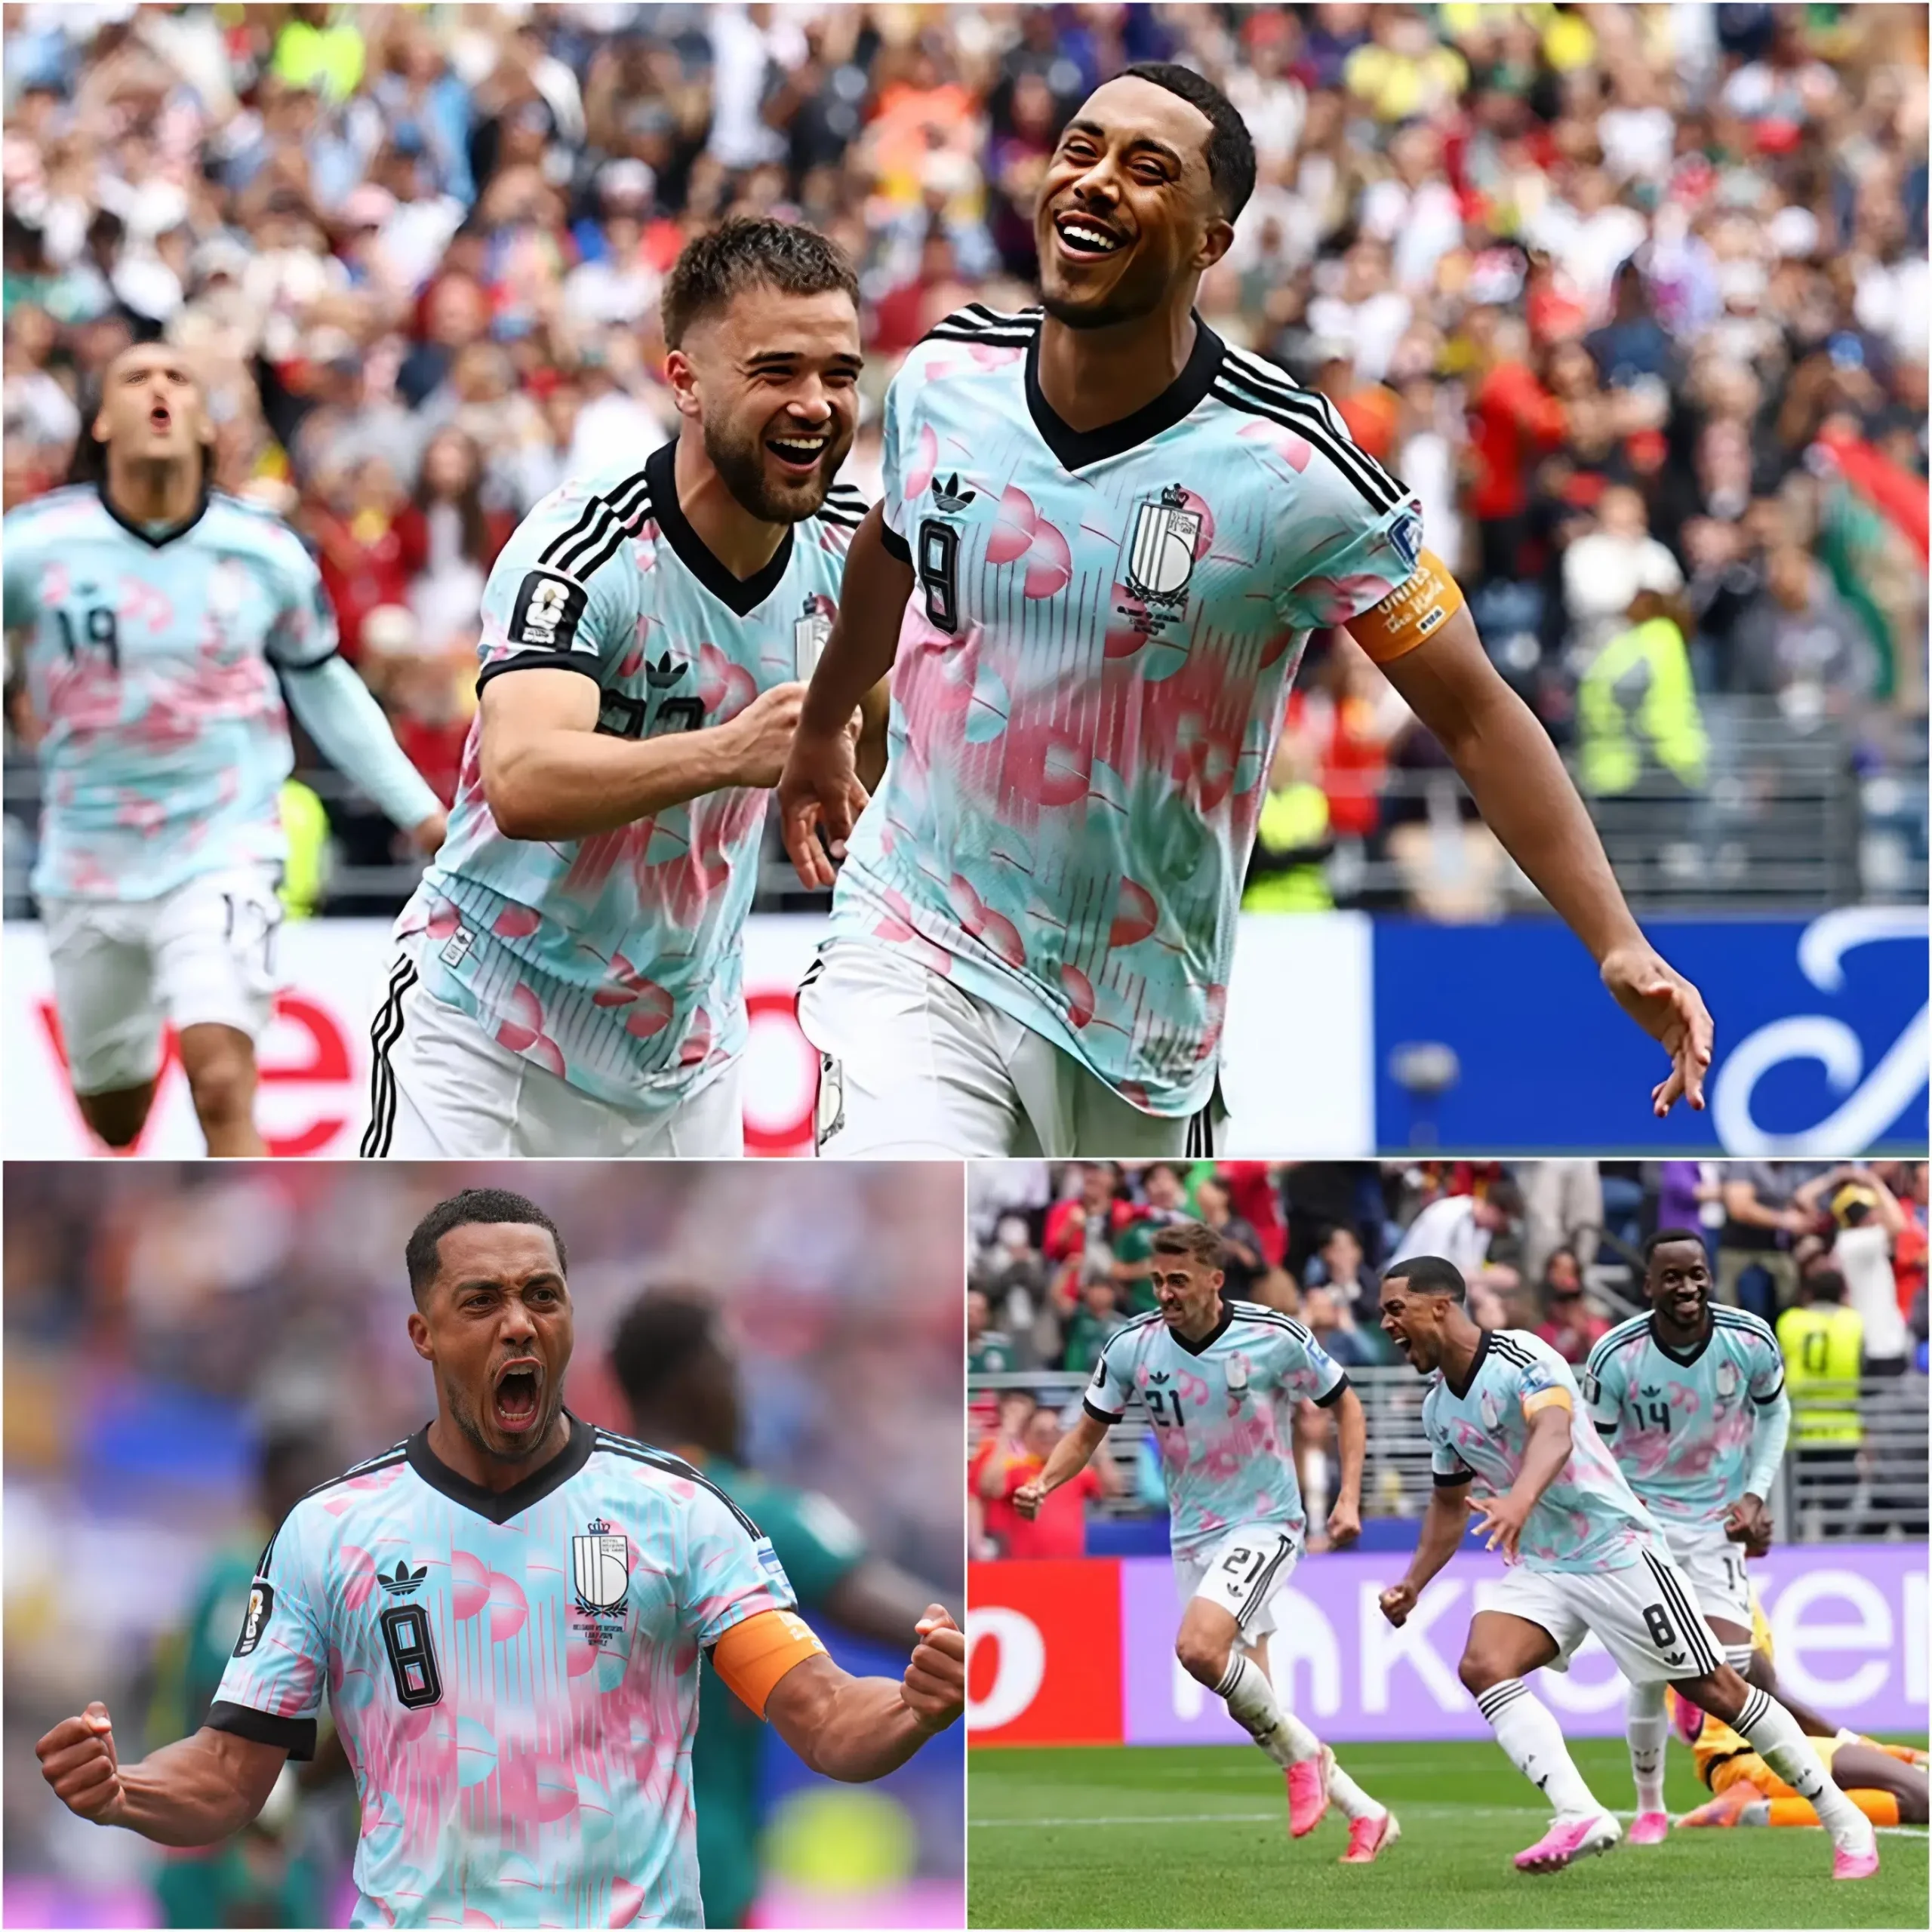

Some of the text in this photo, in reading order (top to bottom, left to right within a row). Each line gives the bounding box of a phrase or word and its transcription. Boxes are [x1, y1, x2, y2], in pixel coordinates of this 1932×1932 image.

[55, 606, 120, 670] 19
[1144, 1390, 1185, 1427] 21
[1631, 1401, 1671, 1435] 14
[1223, 1547, 1265, 1583] 21
[1642, 1603, 1676, 1648] 8
[380, 1604, 444, 1710] 8
